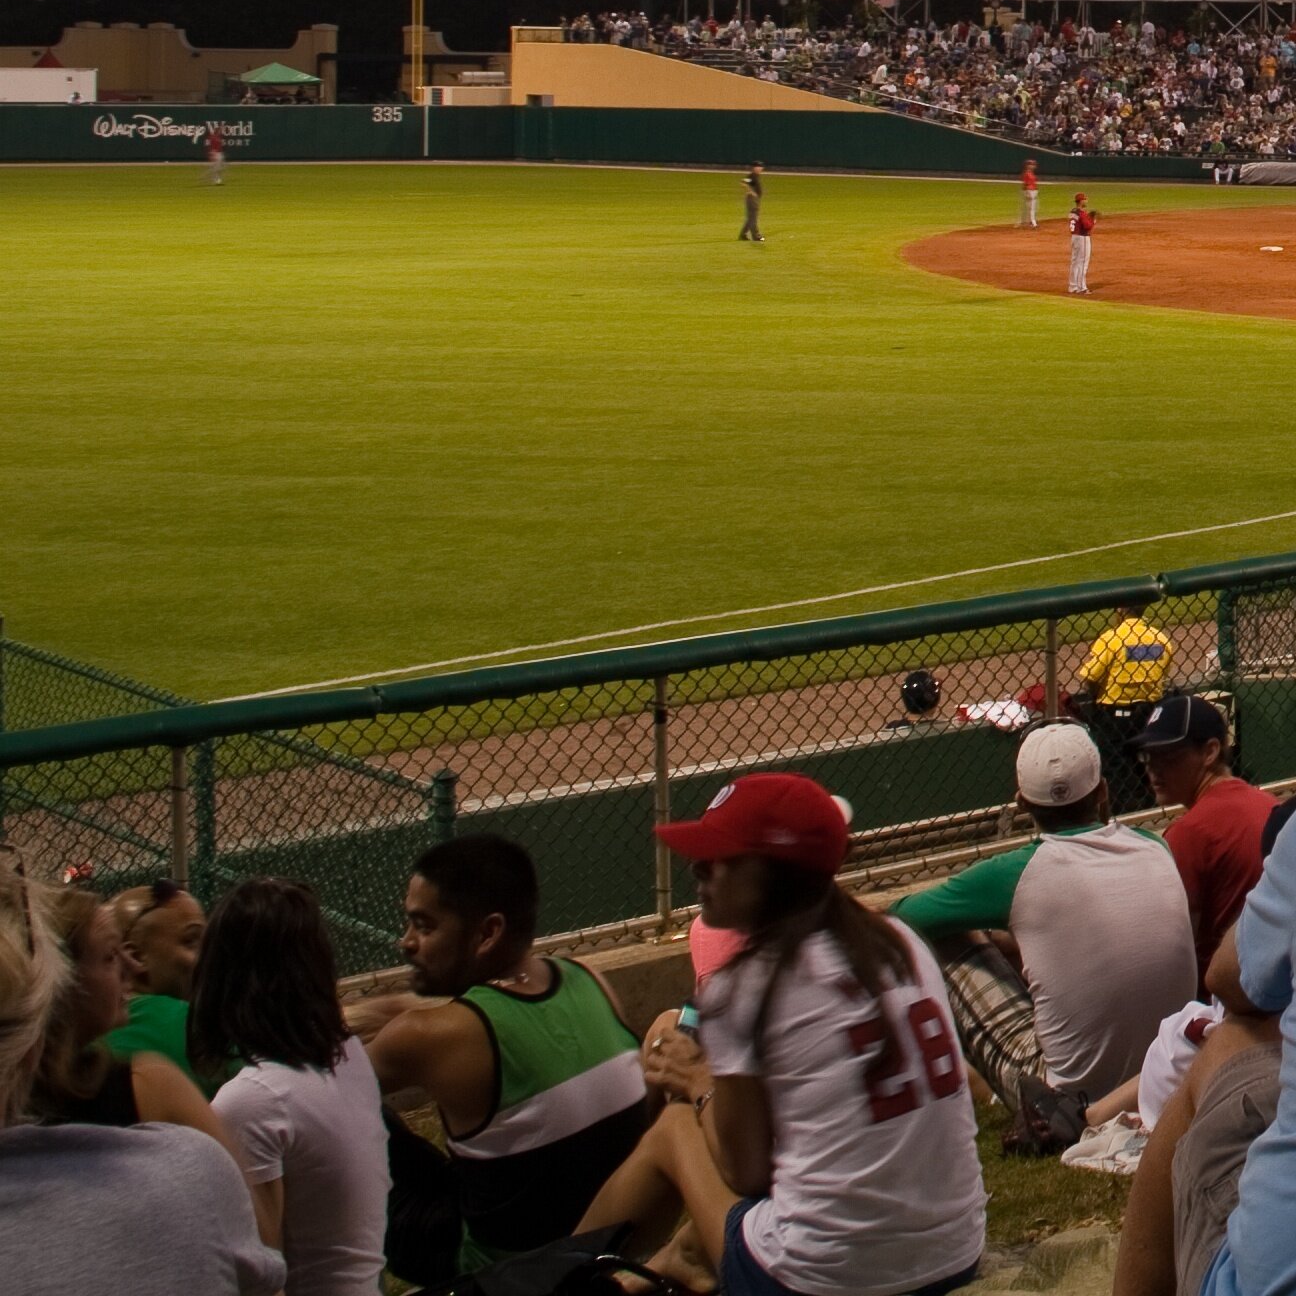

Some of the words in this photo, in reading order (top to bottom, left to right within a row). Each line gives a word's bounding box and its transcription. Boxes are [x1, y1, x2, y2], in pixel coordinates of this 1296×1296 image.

[372, 106, 403, 123] 335
[205, 138, 251, 146] RSORT
[847, 996, 964, 1125] 28
